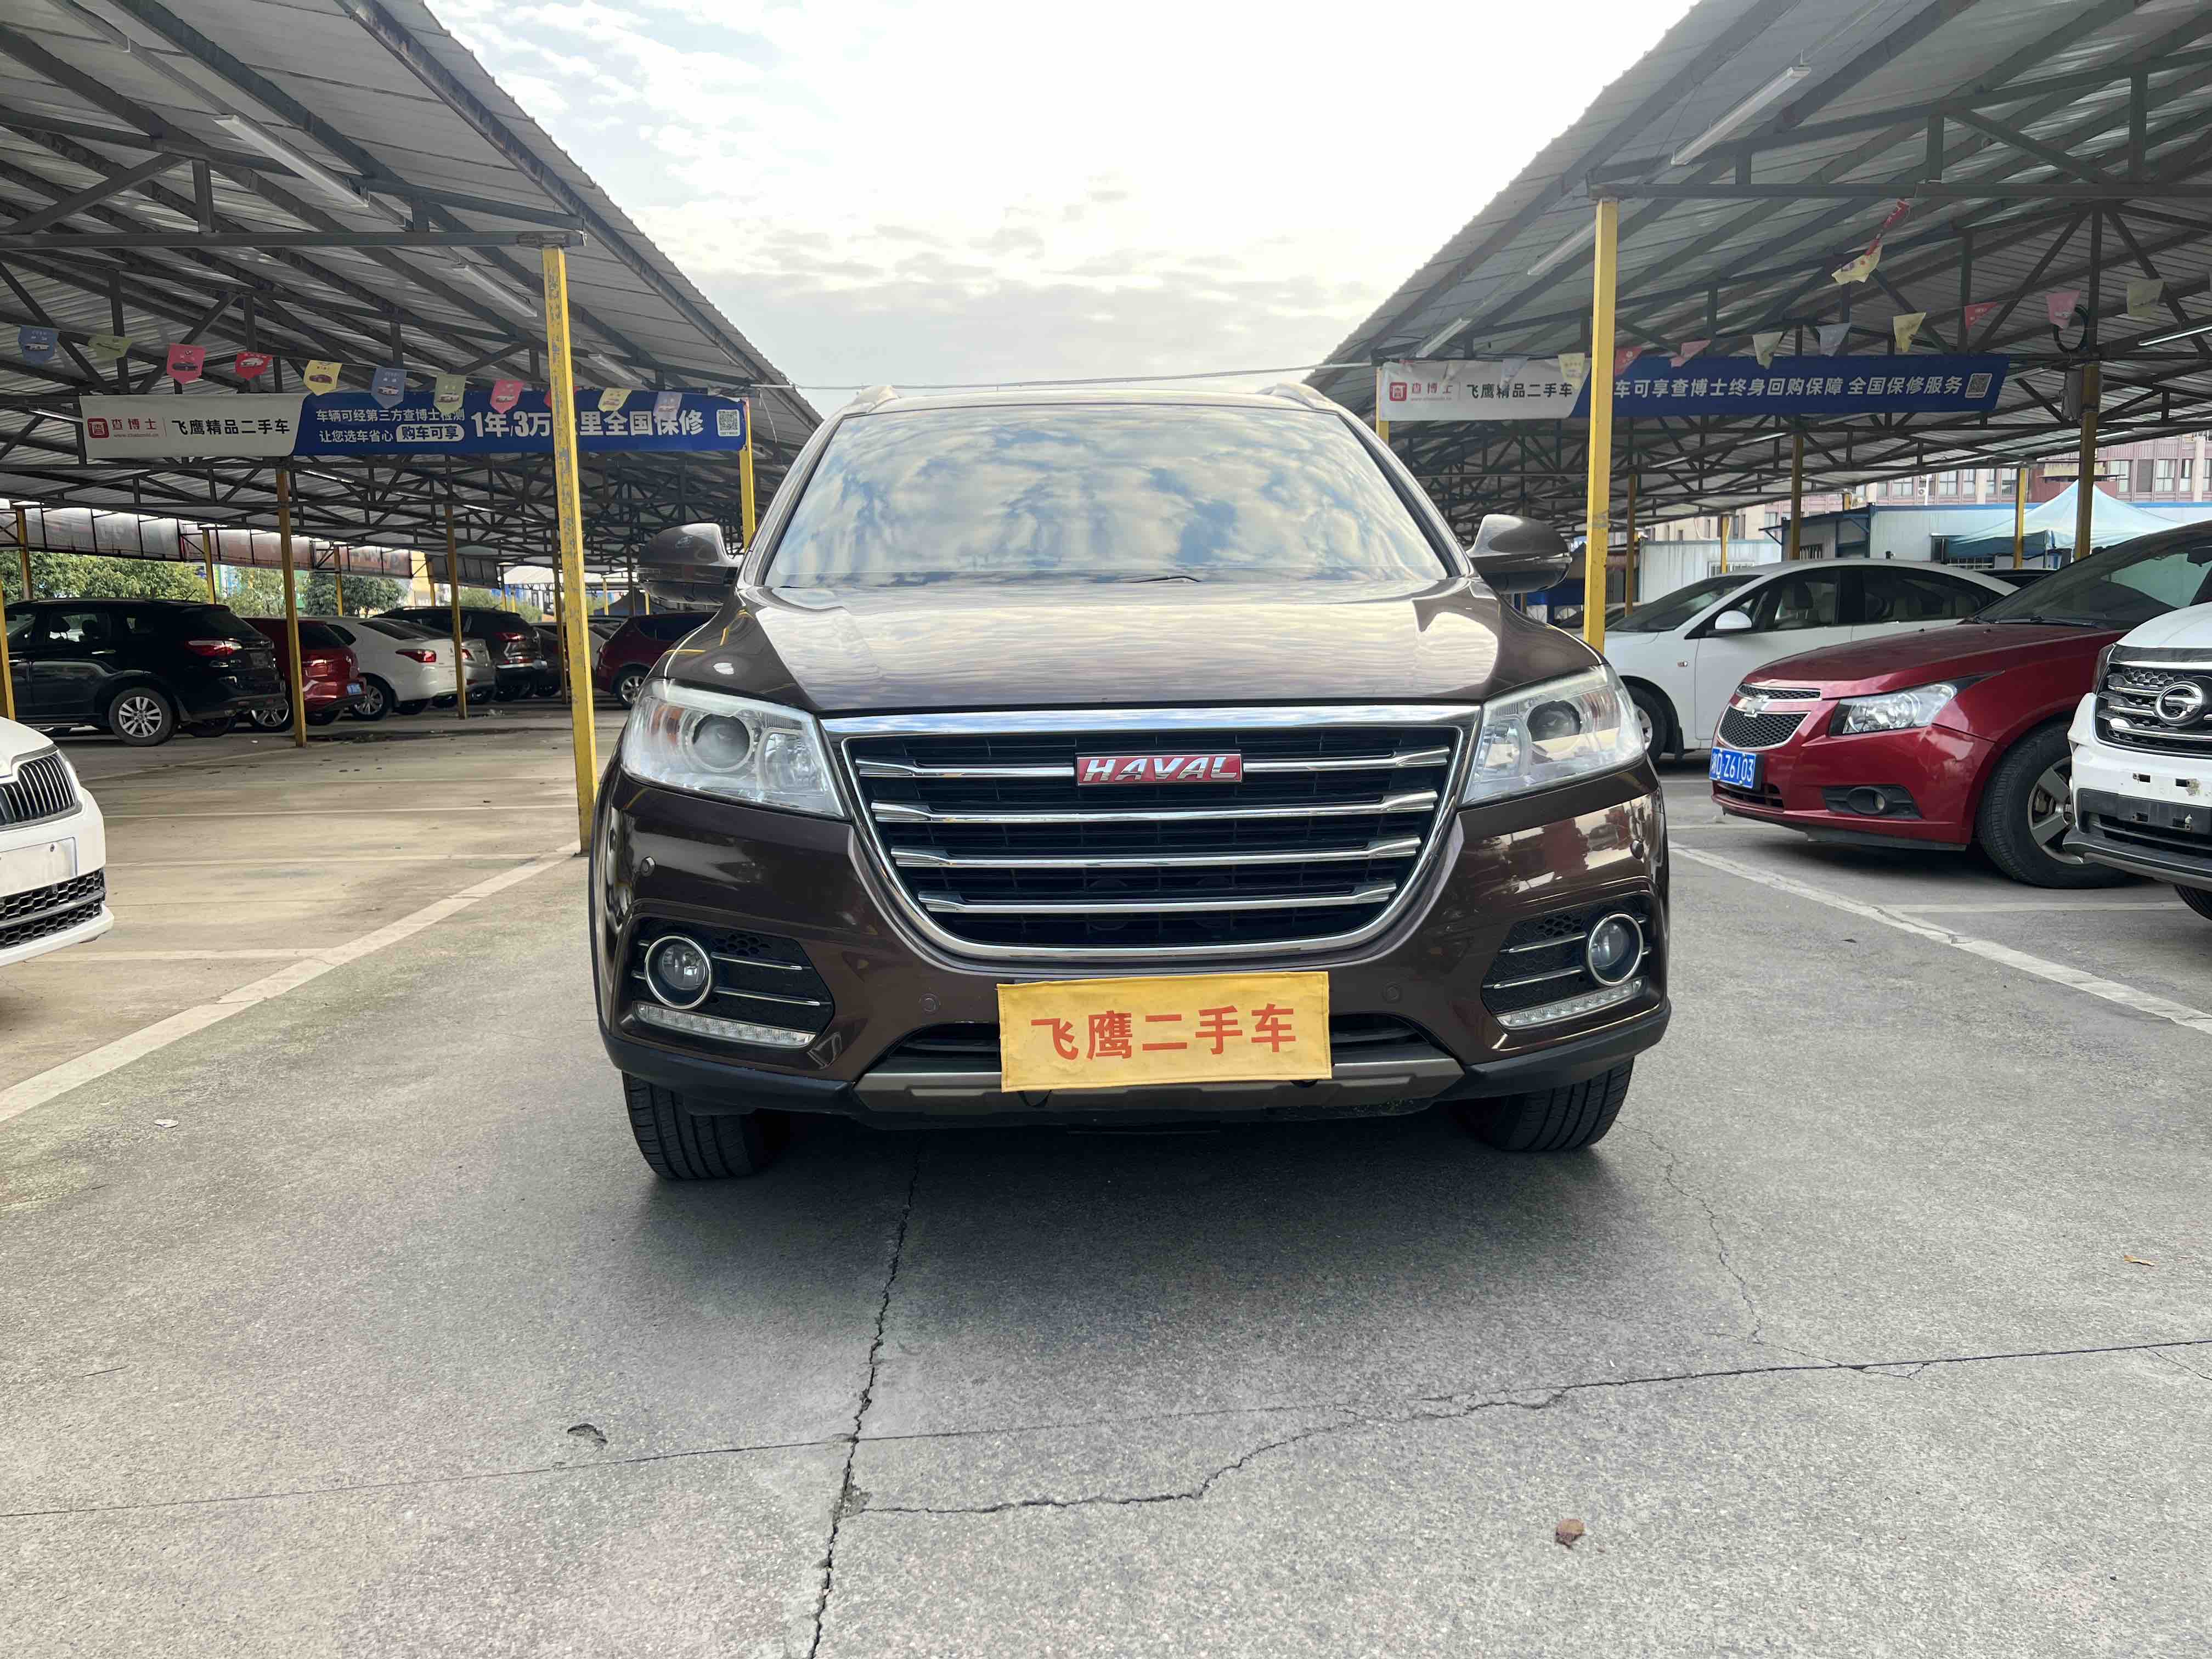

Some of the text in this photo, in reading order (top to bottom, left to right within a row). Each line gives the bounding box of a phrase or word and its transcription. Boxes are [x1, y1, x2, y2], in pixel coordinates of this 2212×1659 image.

[1466, 383, 1573, 399] 飞鹰精品二手车
[1847, 376, 1962, 396] 全国保修服务
[111, 417, 157, 430] 查博士
[316, 408, 465, 422] 车辆可经第三方查博士检测
[471, 409, 704, 437] 1年/3万里全国保修
[171, 419, 290, 435] 飞鹰精品二手车
[320, 426, 459, 443] 让您选车省心 购车可享
[1083, 757, 1237, 782] HAVAL
[1030, 1003, 1296, 1061] 飞鹰二手车
